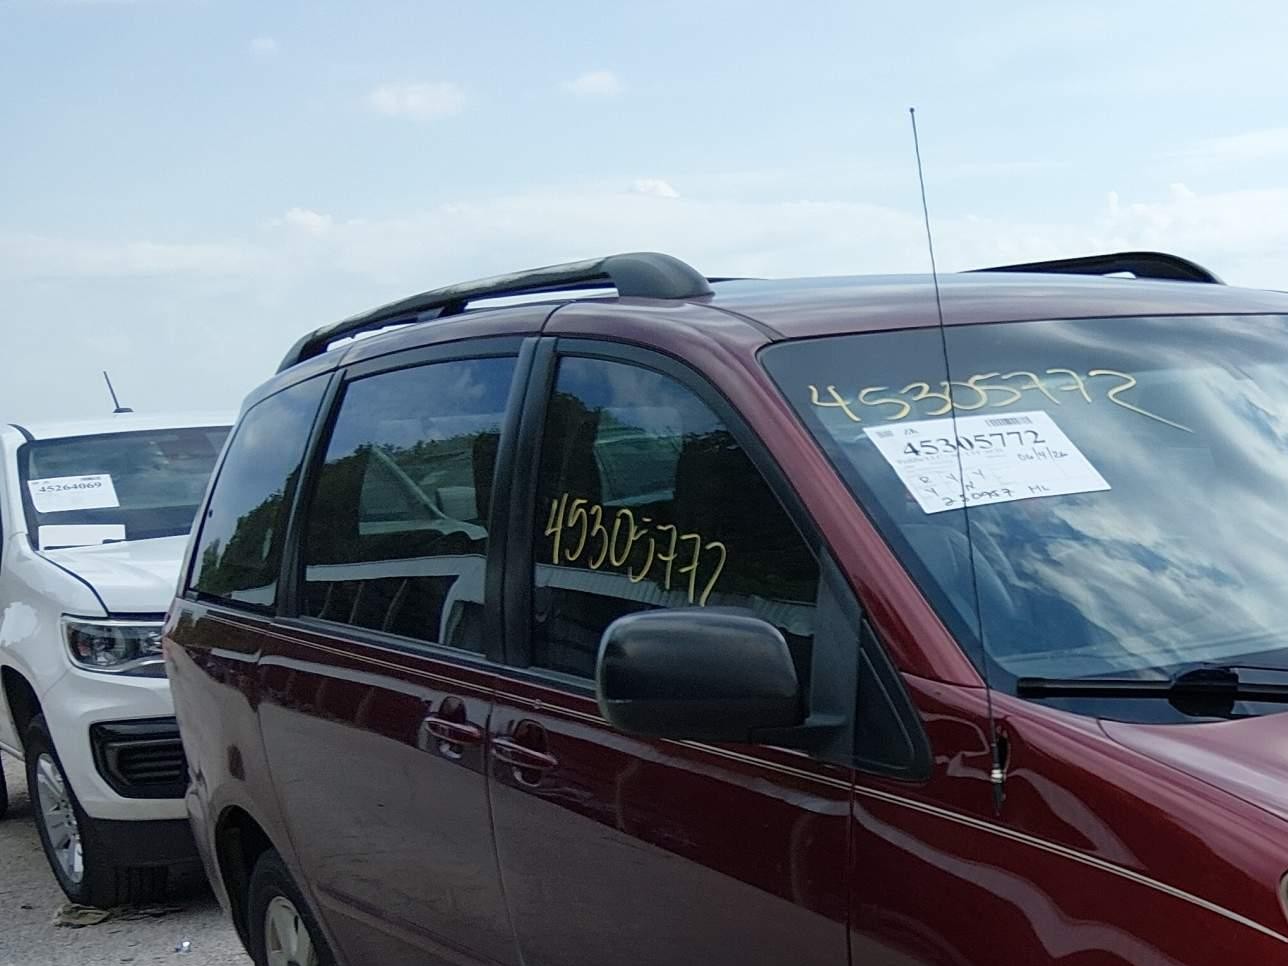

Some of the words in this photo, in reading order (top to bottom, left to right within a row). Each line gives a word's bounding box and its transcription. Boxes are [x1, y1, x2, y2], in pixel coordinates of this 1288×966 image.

[809, 369, 1196, 434] 45305772
[903, 430, 1046, 457] 45305772
[39, 481, 102, 493] 45264069
[544, 492, 727, 608] 45305772
